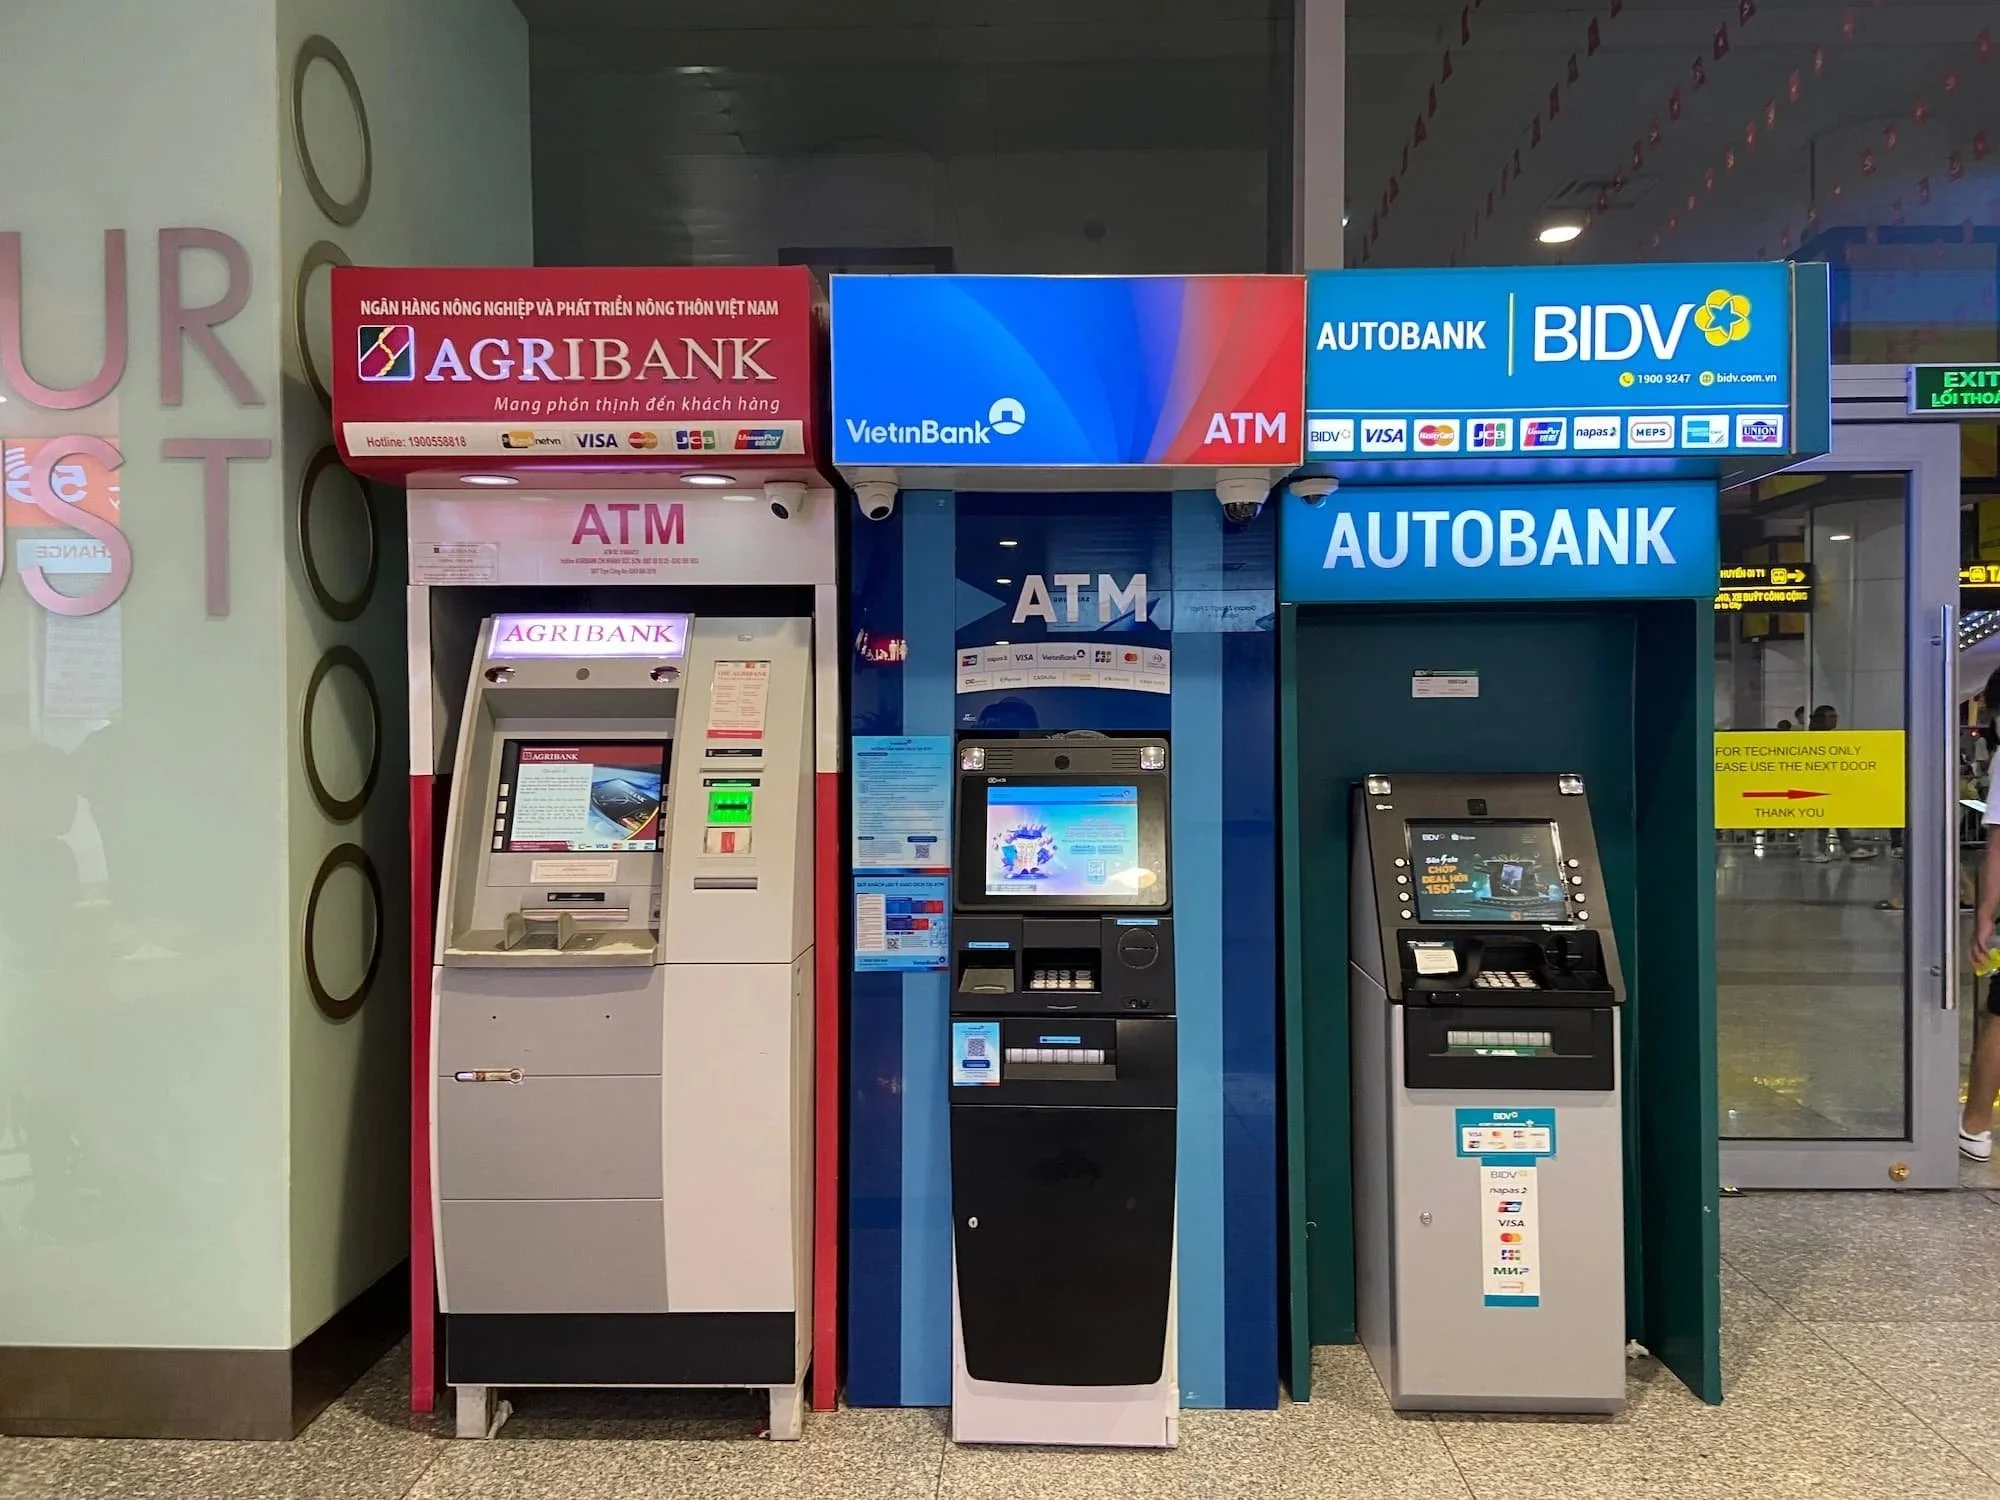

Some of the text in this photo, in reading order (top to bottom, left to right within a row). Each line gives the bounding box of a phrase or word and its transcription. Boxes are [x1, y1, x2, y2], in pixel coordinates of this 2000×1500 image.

[361, 295, 779, 320] NGÂN HÀNG NÔNG NGHIỆP VÀ PHÁT TRIỂN NÔNG THÔN VIỆT NAM
[1316, 320, 1487, 350] AUTOBANK
[1533, 303, 1697, 362] BIDV
[424, 337, 778, 382] AGRIBANK
[1638, 373, 1691, 384] 1900 9247
[1716, 372, 1777, 385] bidv.com.vn
[1943, 371, 2000, 388] EXIT
[494, 397, 541, 415] Mang
[595, 397, 640, 414] thịnh
[646, 394, 675, 412] đến
[681, 396, 731, 411] khách
[737, 397, 780, 414] hàng
[846, 418, 991, 444] VietinBank
[1203, 412, 1287, 444] ATM
[1576, 428, 1609, 439] napas
[1636, 428, 1666, 437] MEPS
[1742, 426, 1777, 436] UNION
[366, 436, 467, 448] Hotline: 1900558818
[576, 433, 618, 448] VISA
[1310, 431, 1340, 442] BIDV
[1365, 428, 1404, 443] VISA
[1473, 430, 1505, 441] JCB
[571, 503, 684, 544] ATM
[1322, 506, 1677, 569] AUTOBANK
[1011, 573, 1147, 623] ATM
[504, 624, 675, 643] AGRIBANK
[532, 752, 578, 761] AGRIBANK
[1715, 746, 1861, 757] FOR TECHNICIANS ONLY
[1750, 762, 1775, 772] USE
[1779, 762, 1801, 771] THE
[1805, 762, 1837, 771] NEXT
[1840, 761, 1877, 771] DOOR
[1755, 808, 1825, 818] THANK YOU
[1490, 1170, 1517, 1179] BIDV
[1490, 1186, 1519, 1195] napas
[1498, 1219, 1525, 1228] VISA
